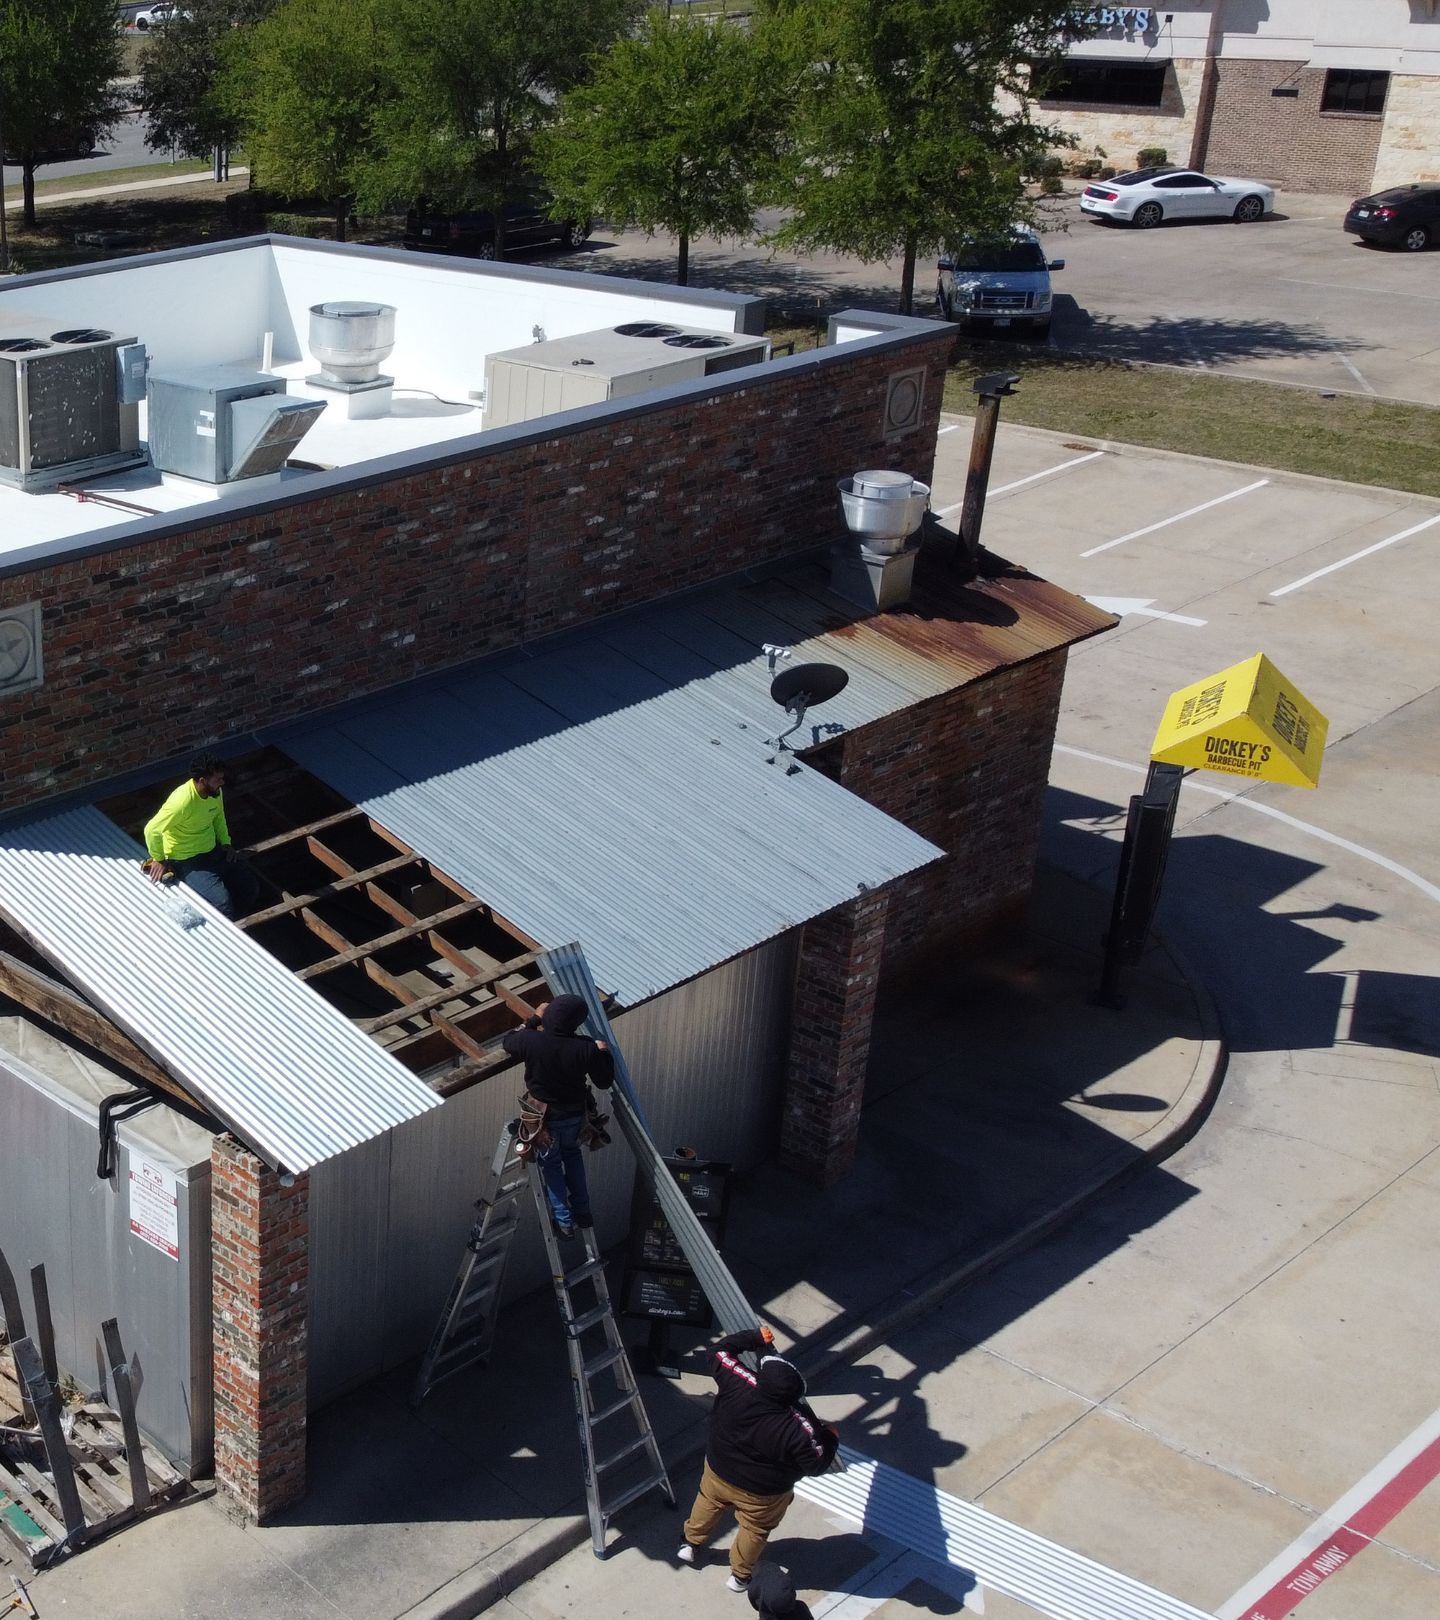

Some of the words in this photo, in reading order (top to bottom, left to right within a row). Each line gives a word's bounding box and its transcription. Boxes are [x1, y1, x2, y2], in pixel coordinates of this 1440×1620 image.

[1205, 736, 1271, 761] DICKEY'S
[1203, 763, 1246, 775] CLEARANCE
[1208, 754, 1247, 768] BARBECUE
[1248, 760, 1262, 771] PIT
[1286, 1569, 1321, 1595] TOW
[1312, 1545, 1349, 1575] AWAY
